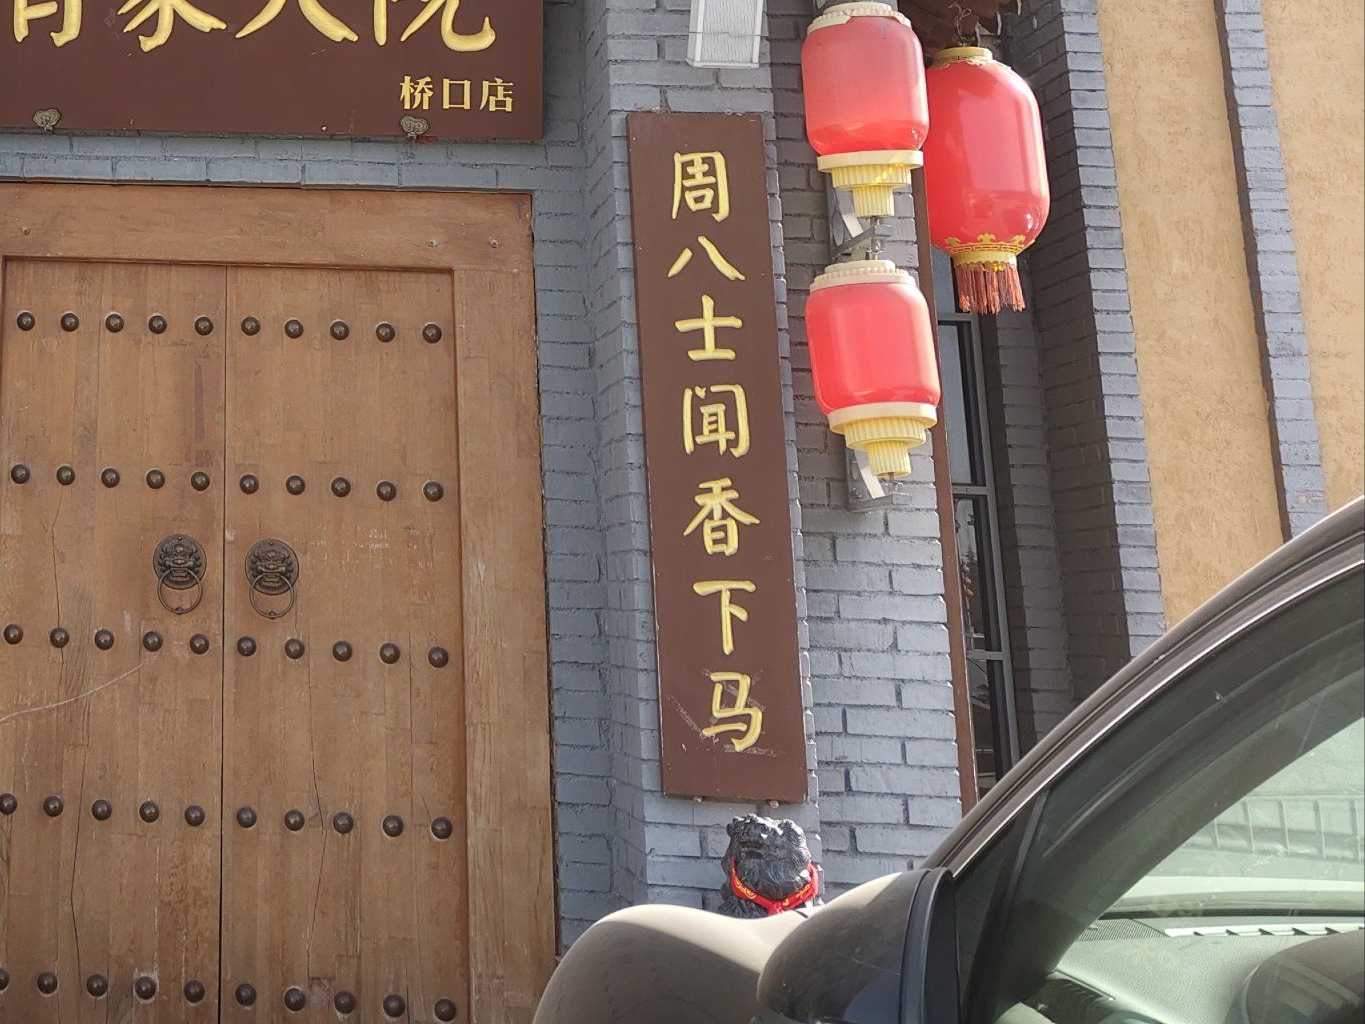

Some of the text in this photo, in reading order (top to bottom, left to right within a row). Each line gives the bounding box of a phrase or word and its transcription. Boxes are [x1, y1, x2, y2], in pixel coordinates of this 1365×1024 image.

[399, 75, 514, 112] 桥口店
[668, 150, 764, 752] 周八士闻香下马
